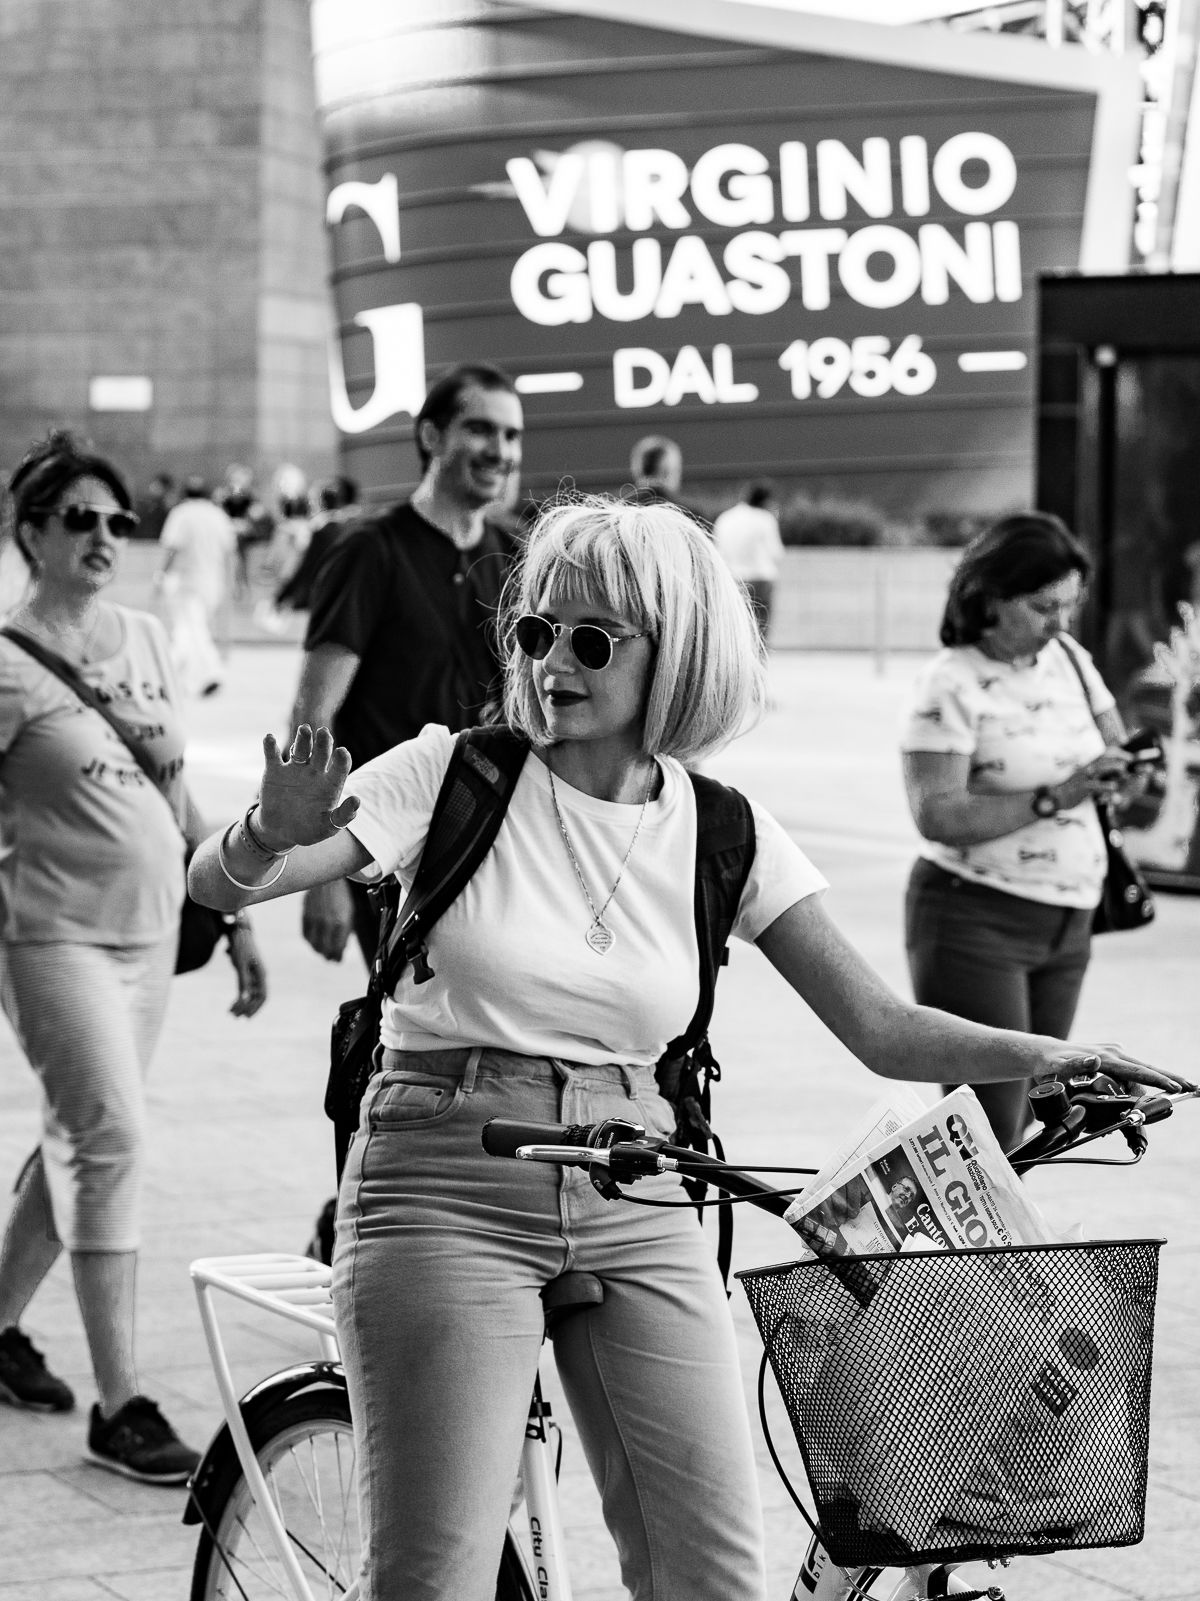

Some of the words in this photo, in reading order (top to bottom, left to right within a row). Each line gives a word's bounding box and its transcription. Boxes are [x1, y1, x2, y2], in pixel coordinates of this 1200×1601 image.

[505, 131, 1017, 237] VIRGINIO
[509, 220, 1022, 326] GUASTONI
[612, 343, 759, 408] DAL
[778, 334, 938, 399] 1956
[946, 1113, 979, 1161] QN
[917, 1124, 951, 1178] IL
[944, 1180, 997, 1248] GIO
[970, 1159, 988, 1191] Quotidiano
[537, 1566, 548, 1601] Cla
